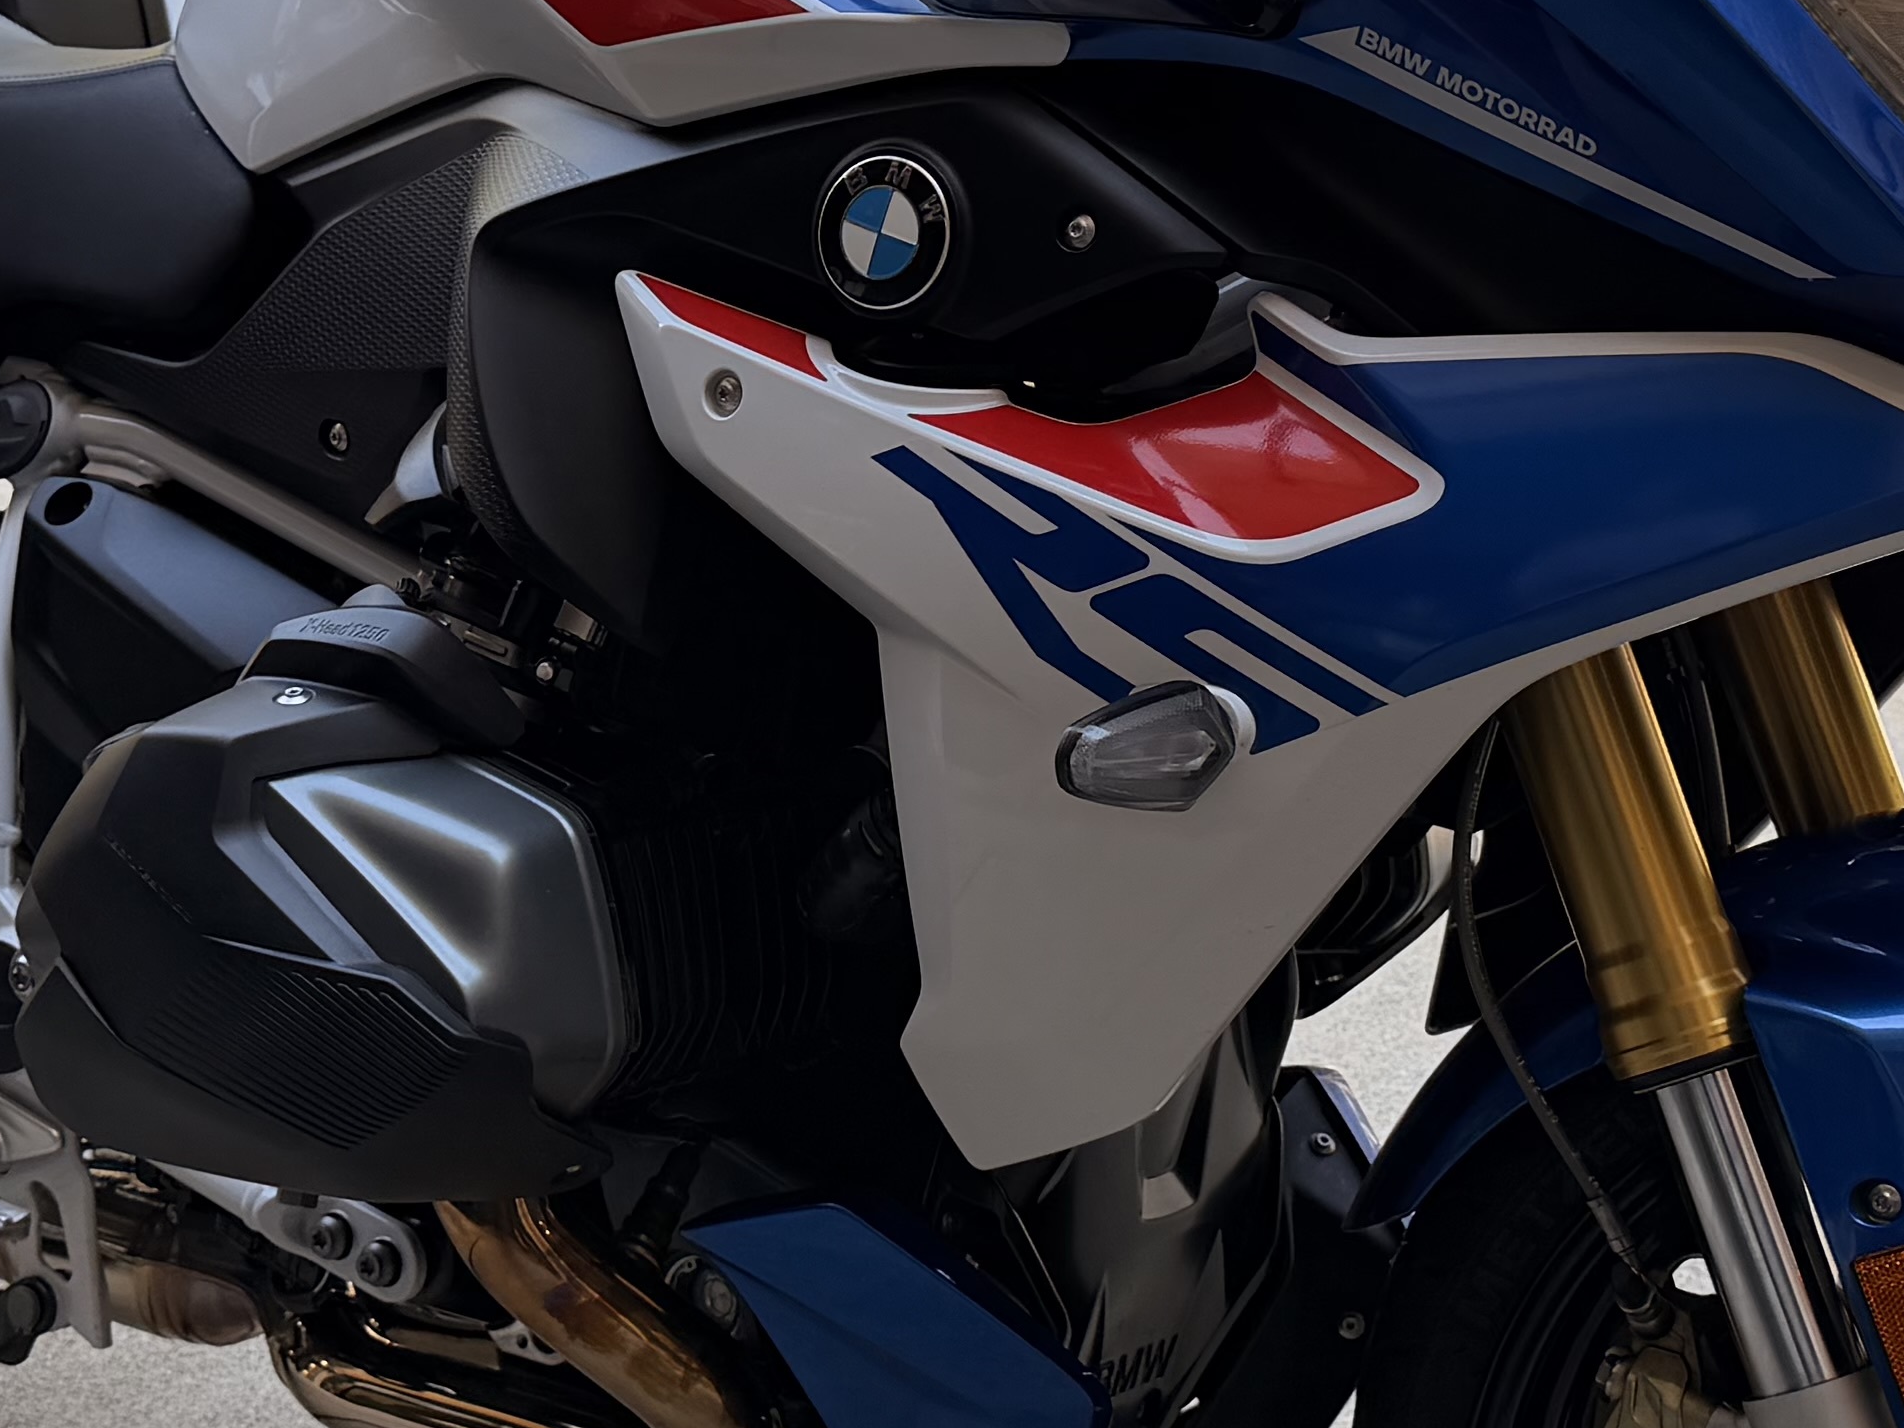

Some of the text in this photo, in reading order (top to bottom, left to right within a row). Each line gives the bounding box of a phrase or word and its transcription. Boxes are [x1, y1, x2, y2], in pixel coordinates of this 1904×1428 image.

[1360, 27, 1598, 158] BMW MOTORRAD
[844, 161, 947, 224] BMW
[871, 444, 1389, 756] RS
